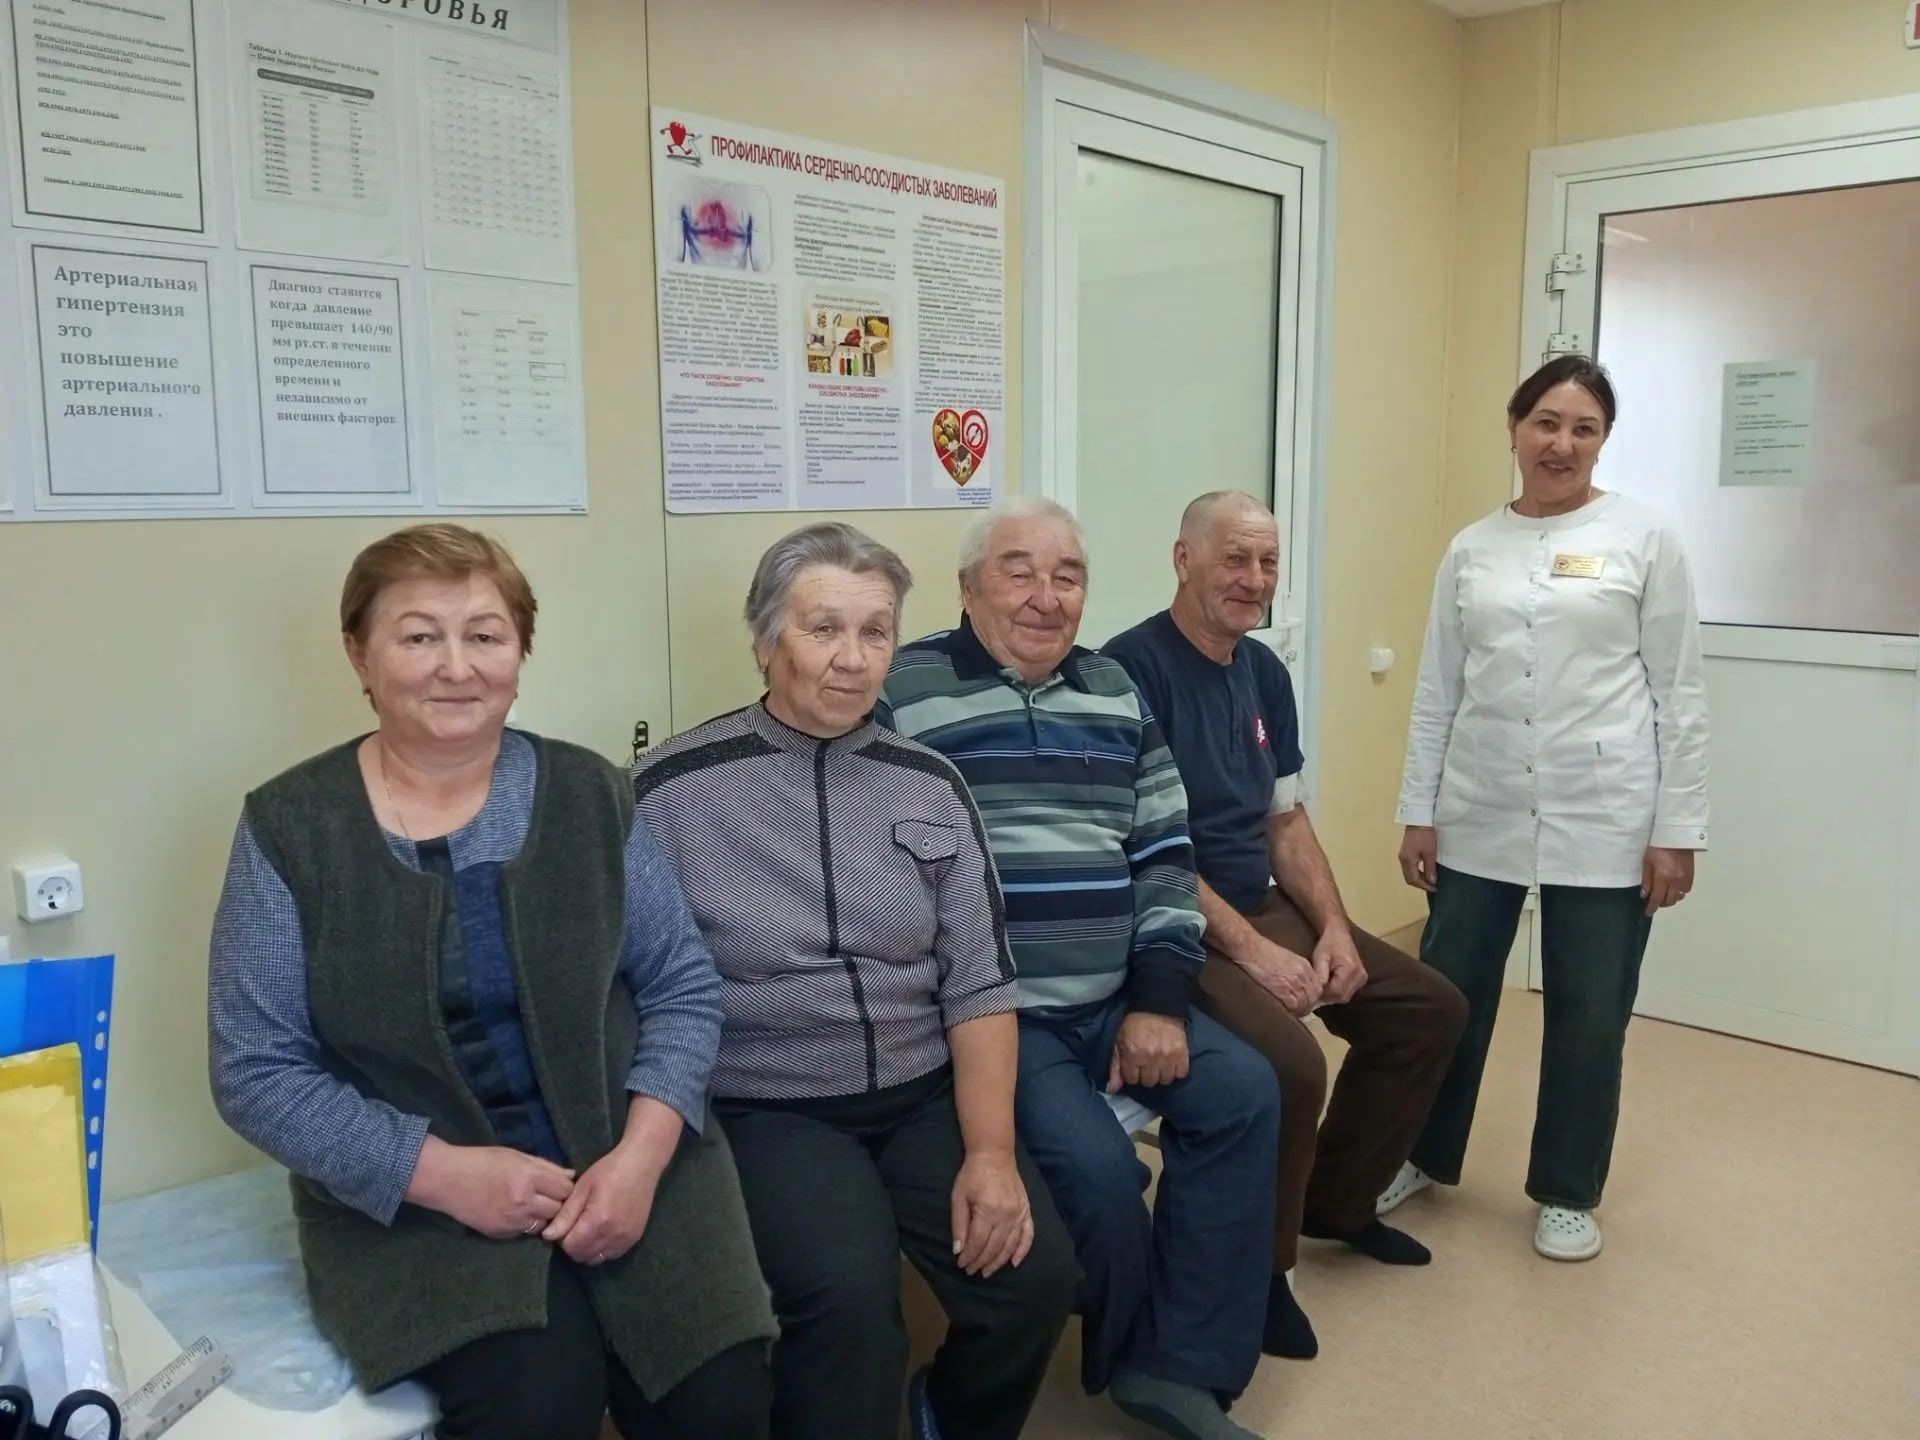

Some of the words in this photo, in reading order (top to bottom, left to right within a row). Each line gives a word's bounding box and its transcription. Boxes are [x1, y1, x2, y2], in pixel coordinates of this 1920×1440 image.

[711, 135, 802, 172] ПРОФИЛАКТИКА
[804, 154, 931, 197] СЕРДЕЧНО-СОСУДИСТЫХ
[932, 180, 998, 209] ЗАБОЛЕВАНИЙ
[54, 265, 199, 292] Артериальная
[268, 279, 322, 294] Диагноз
[328, 285, 383, 299] ставится
[56, 296, 185, 317] гипертензия
[270, 300, 307, 312] когда
[313, 303, 372, 316] давление
[57, 324, 92, 338] это
[271, 319, 344, 333] превышает
[351, 322, 393, 336] 140/90
[272, 337, 291, 347] мм
[294, 339, 329, 350] рт.ст.
[331, 340, 339, 350] в
[60, 351, 179, 369] повышение
[273, 356, 371, 370] определенного
[61, 378, 201, 395] артериального
[275, 375, 330, 387] времени
[332, 377, 342, 387] и
[276, 393, 351, 405] независимо
[353, 396, 368, 405] от
[277, 412, 335, 423] внешних
